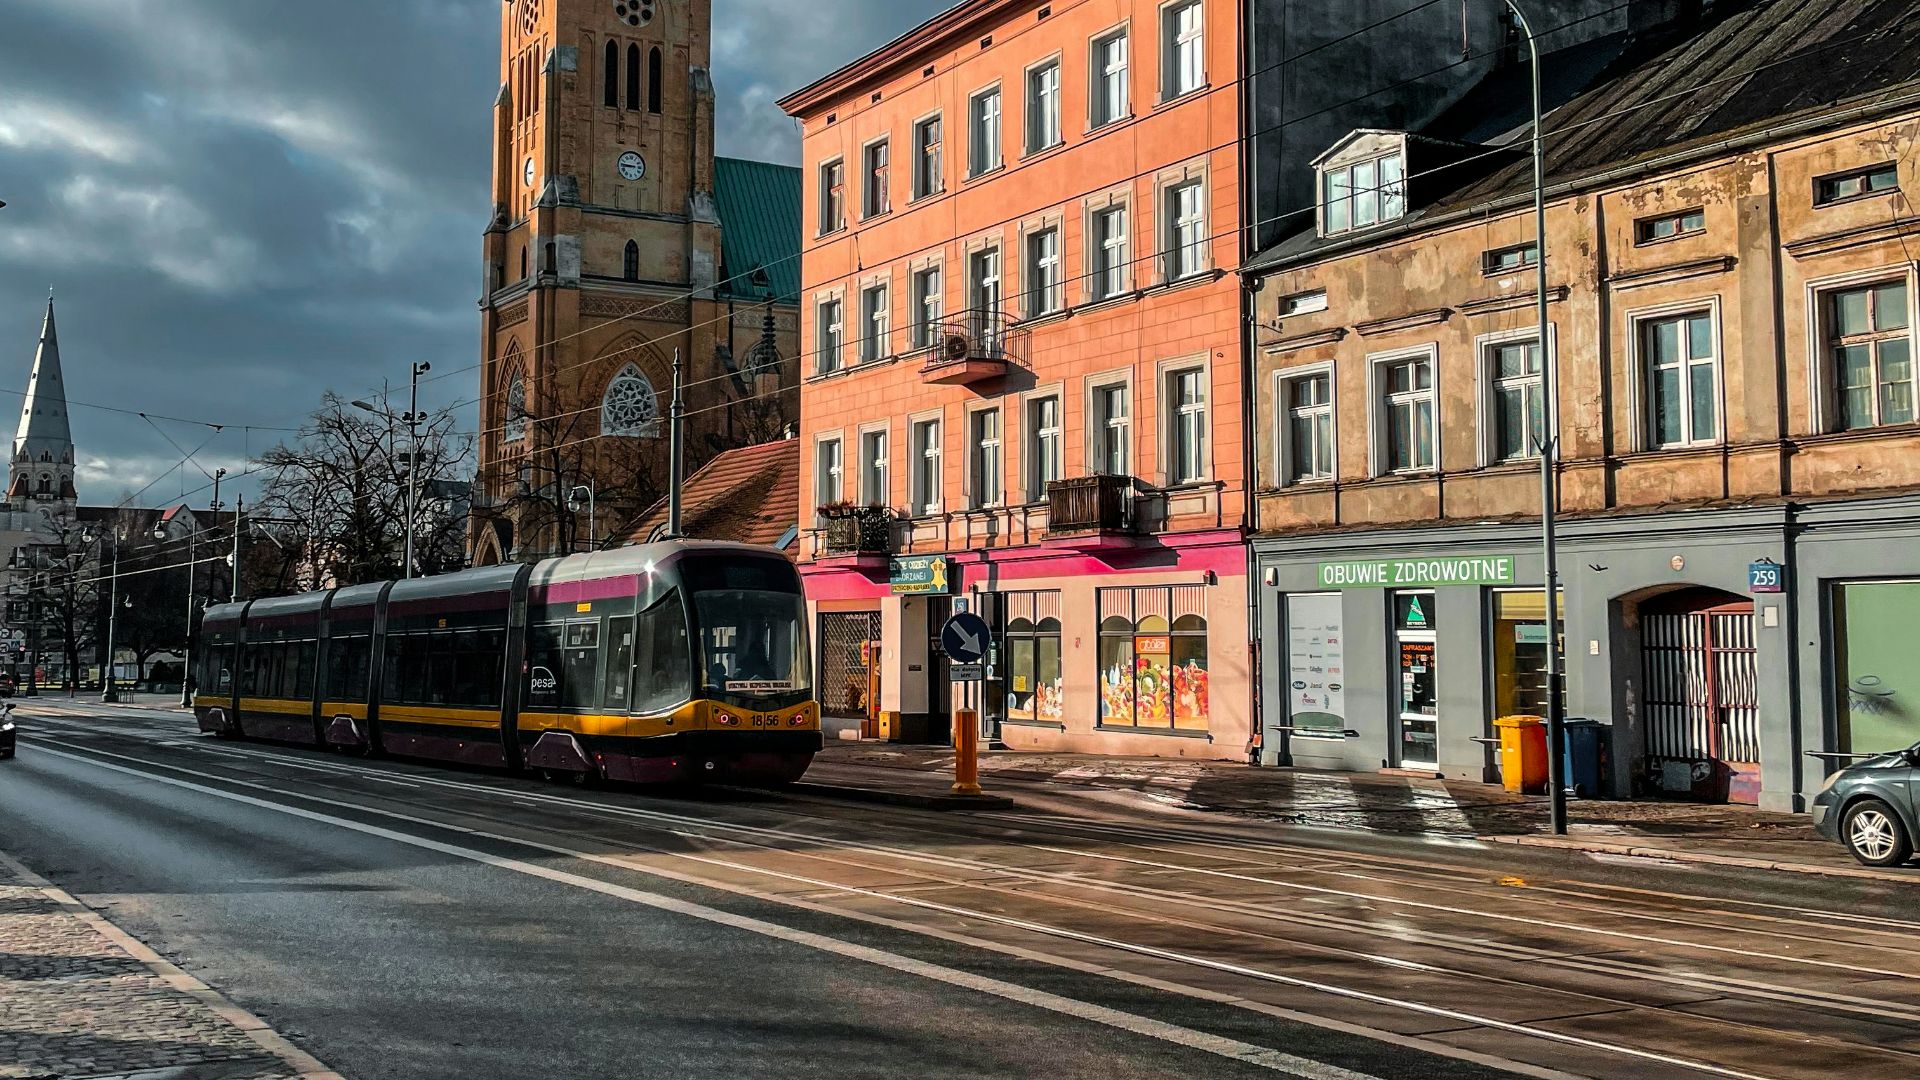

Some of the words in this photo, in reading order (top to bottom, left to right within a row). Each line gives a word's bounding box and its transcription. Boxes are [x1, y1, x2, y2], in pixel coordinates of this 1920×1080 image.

[1324, 564, 1388, 584] OBUWIE
[1394, 559, 1509, 582] ZDROWOTNE
[1753, 570, 1776, 586] 259
[531, 678, 553, 688] pesa
